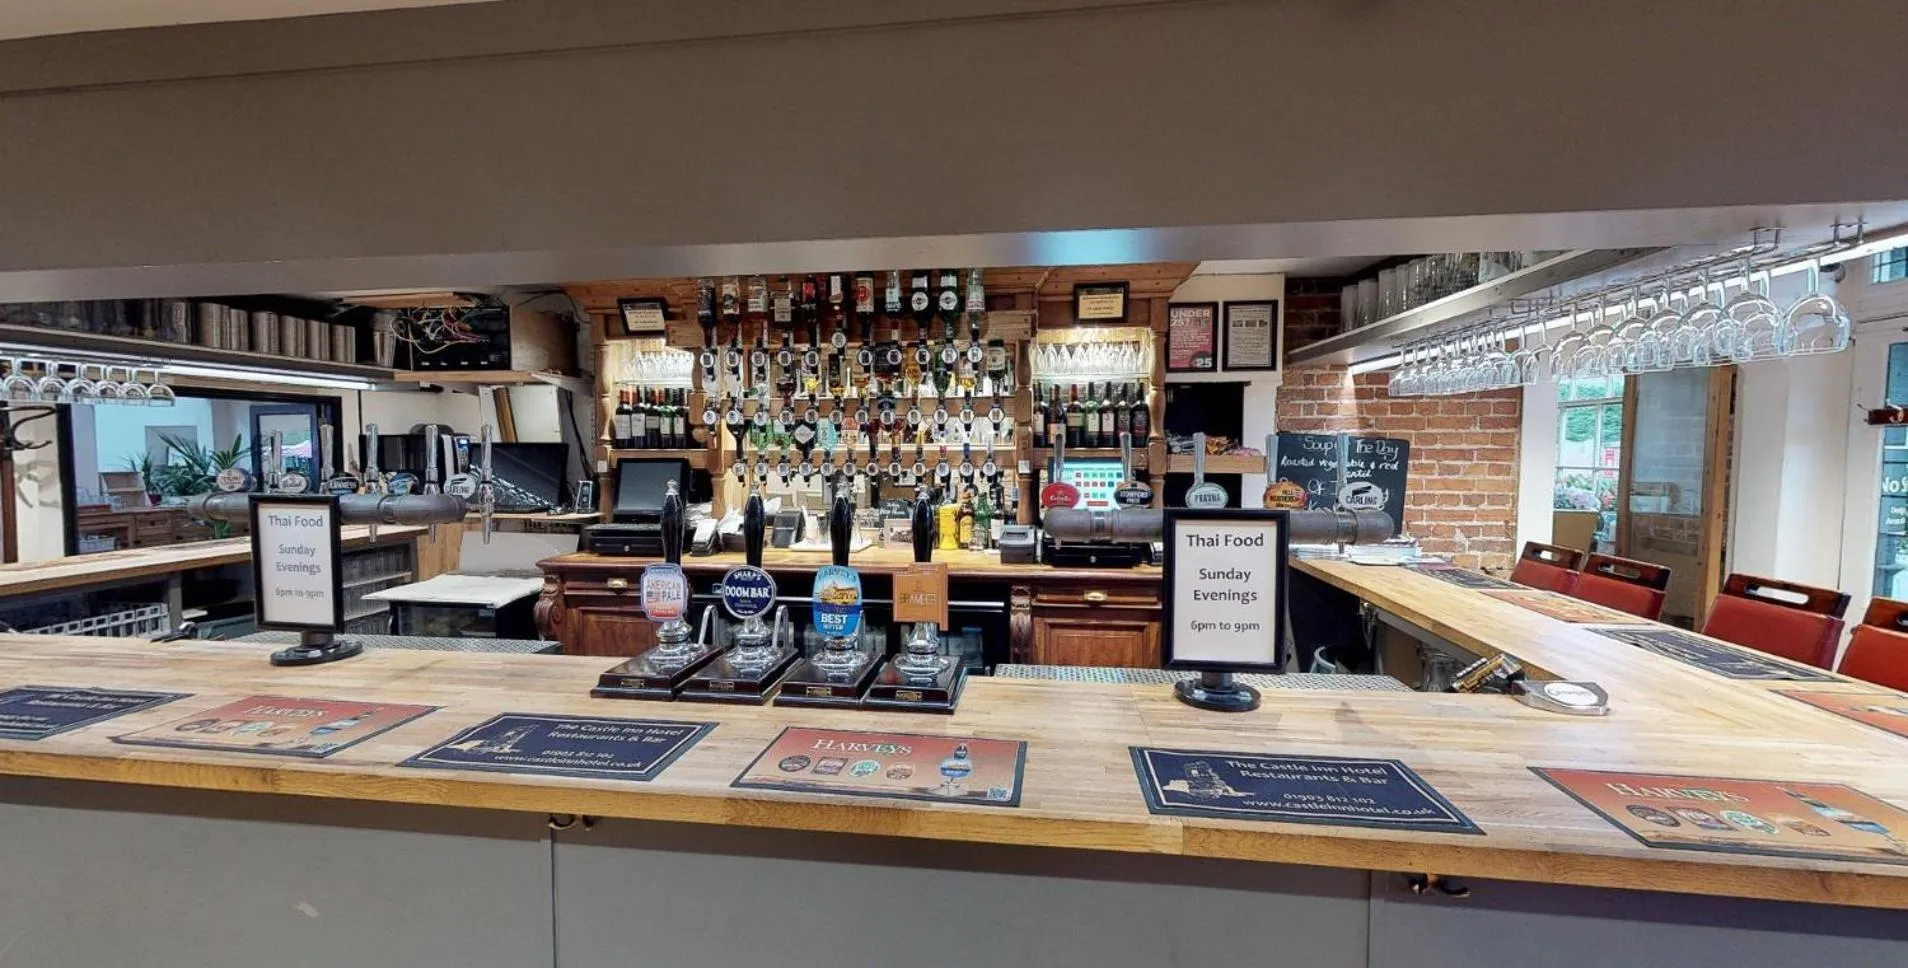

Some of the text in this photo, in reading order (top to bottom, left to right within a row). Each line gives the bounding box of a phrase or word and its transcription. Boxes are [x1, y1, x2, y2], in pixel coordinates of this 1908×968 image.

[1170, 308, 1213, 319] UNDER
[1302, 435, 1334, 456] Soup
[1356, 438, 1374, 454] The
[1375, 440, 1400, 462] Day
[1379, 460, 1400, 471] red
[1345, 495, 1378, 505] CARLING
[267, 514, 324, 528] Thai Food
[1185, 533, 1265, 548] Thai Food
[278, 543, 316, 558] Sunday
[275, 561, 322, 576] Evenings
[1198, 567, 1252, 583] Sunday
[295, 588, 304, 597] to
[724, 585, 771, 599] DOOM BAR
[1192, 588, 1259, 606] Evenings
[821, 612, 849, 625] BEST
[1189, 619, 1261, 634] 6pm to 9pm
[644, 728, 684, 737] Hotel
[810, 737, 913, 755] HARVEYS
[1226, 760, 1388, 776] The Castle Inn Hotel
[1239, 769, 1388, 786] Restaurants & Bar
[1242, 798, 1436, 816] www.castleinnhotel.co.uk
